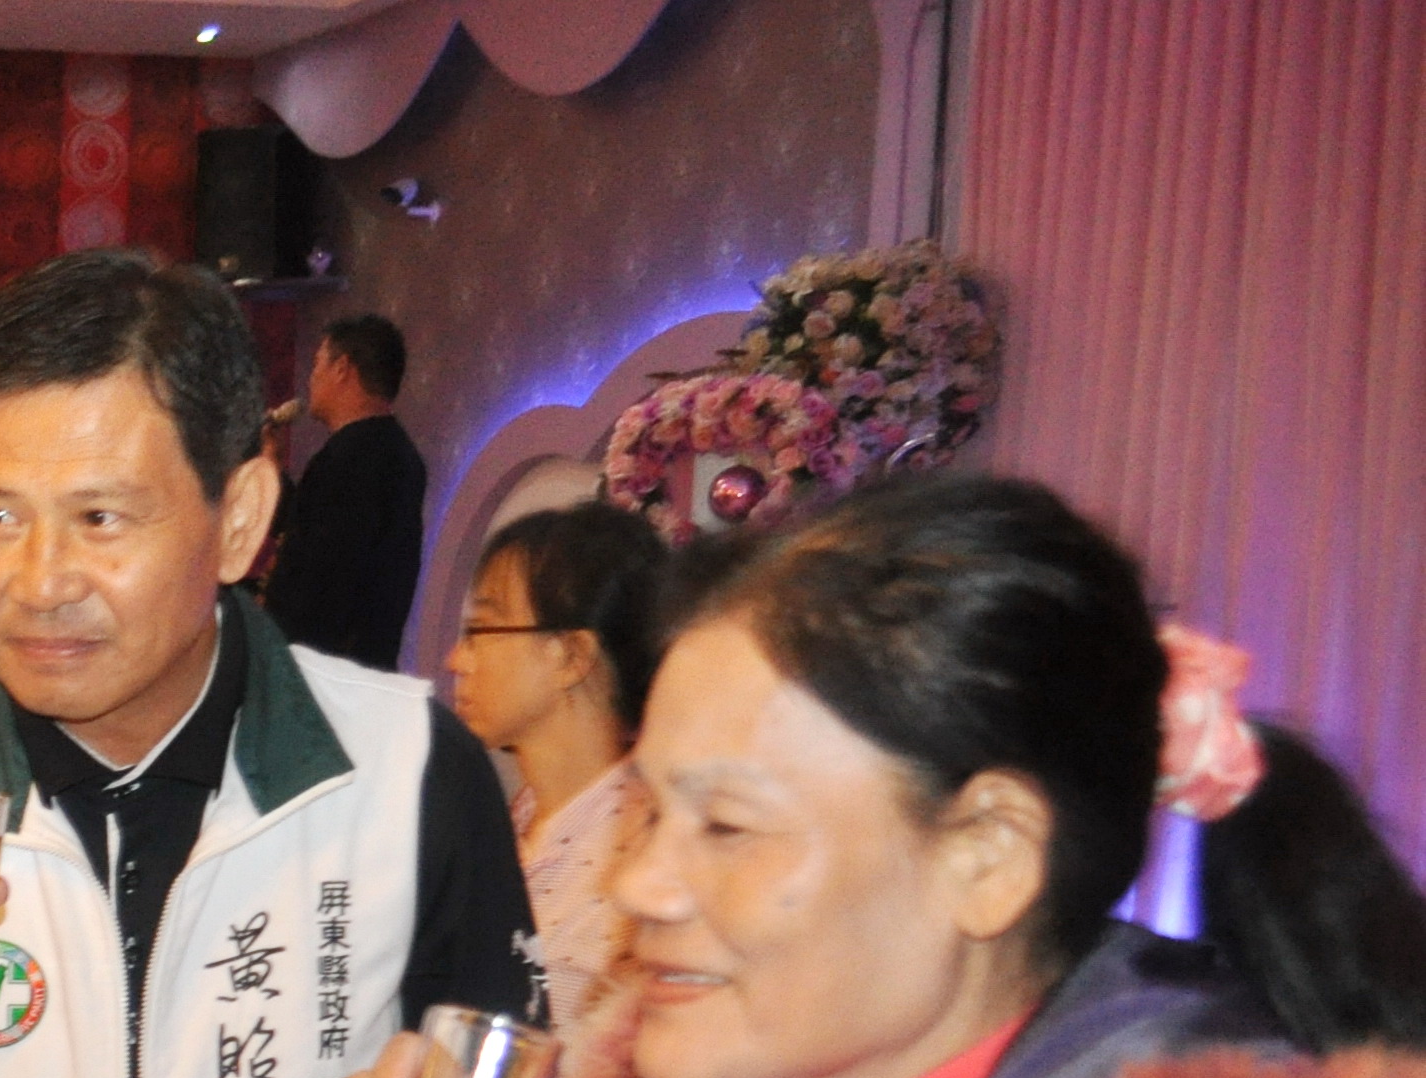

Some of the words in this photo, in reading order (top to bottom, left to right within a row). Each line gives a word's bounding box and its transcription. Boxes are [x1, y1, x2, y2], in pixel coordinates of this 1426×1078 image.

[317, 879, 352, 1060] 屏東縣政府
